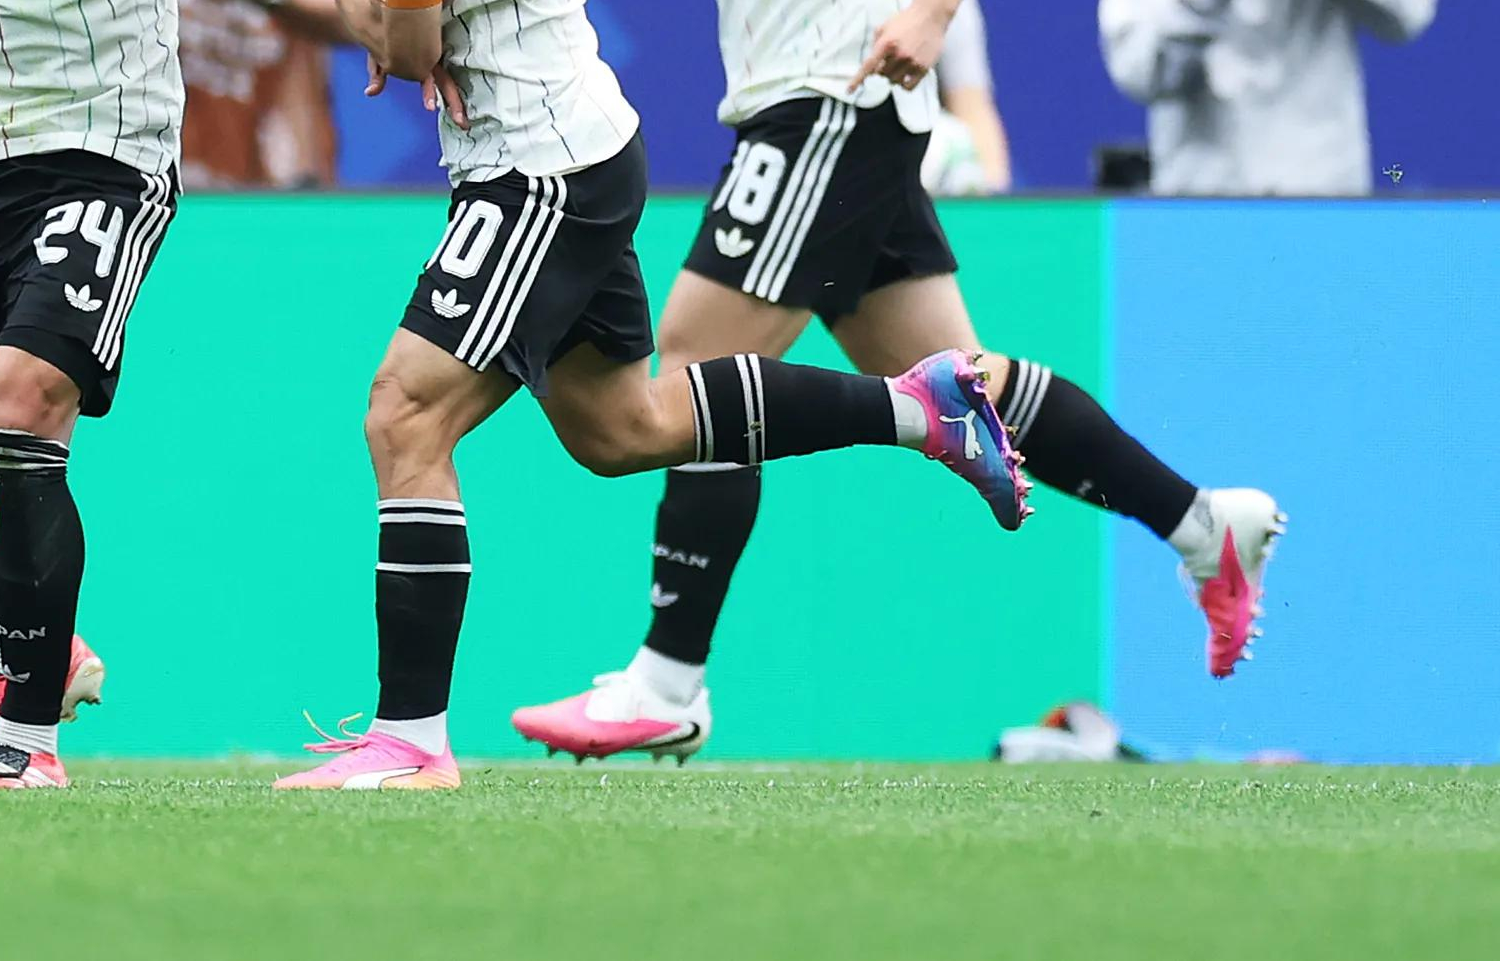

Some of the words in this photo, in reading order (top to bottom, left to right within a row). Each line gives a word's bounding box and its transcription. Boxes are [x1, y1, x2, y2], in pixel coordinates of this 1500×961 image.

[712, 140, 787, 226] 18
[33, 199, 124, 278] 24
[425, 199, 504, 279] 10
